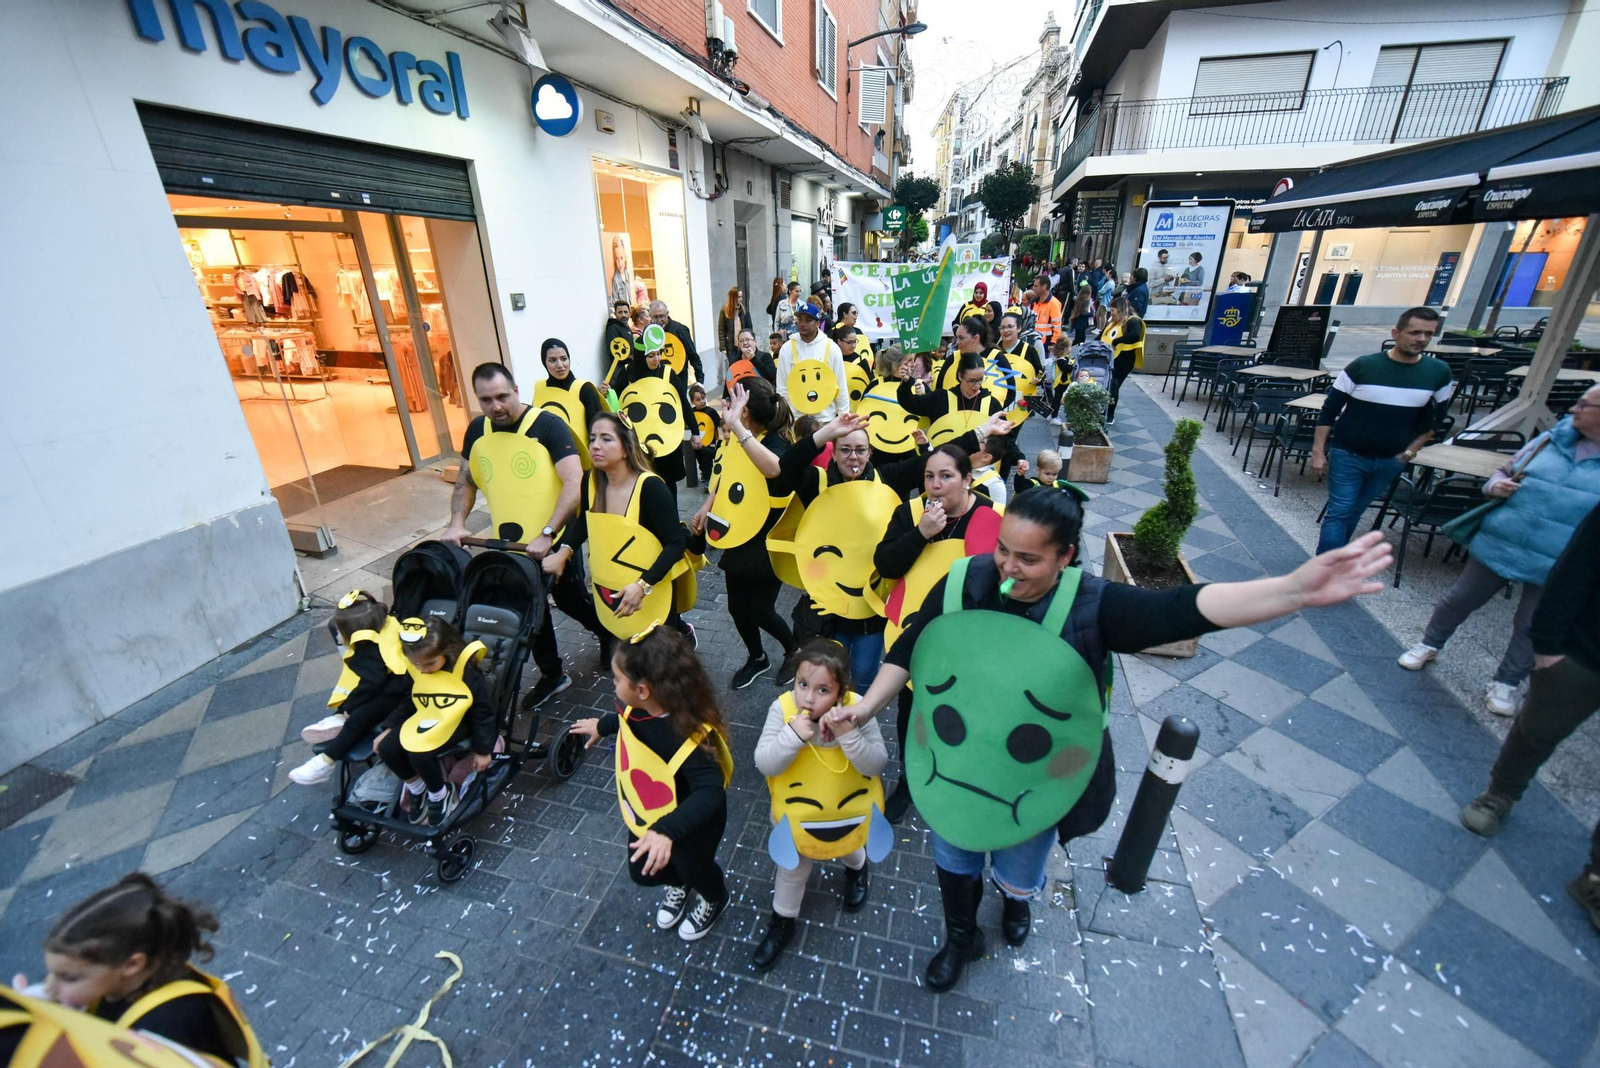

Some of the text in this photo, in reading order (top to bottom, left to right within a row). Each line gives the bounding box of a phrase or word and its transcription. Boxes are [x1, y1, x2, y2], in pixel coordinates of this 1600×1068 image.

[127, 0, 471, 119] mayoral
[1483, 188, 1533, 201] Cruzcampo
[1415, 199, 1452, 211] Cruzcampo
[1486, 201, 1515, 210] ESPECIAL
[1293, 210, 1307, 228] LA
[1306, 208, 1337, 228] CATA
[1417, 210, 1438, 219] ESPECIAL
[892, 266, 941, 292] LA ÚL
[895, 295, 921, 310] VEZ
[897, 316, 920, 332] FUE
[903, 337, 920, 350] DE
